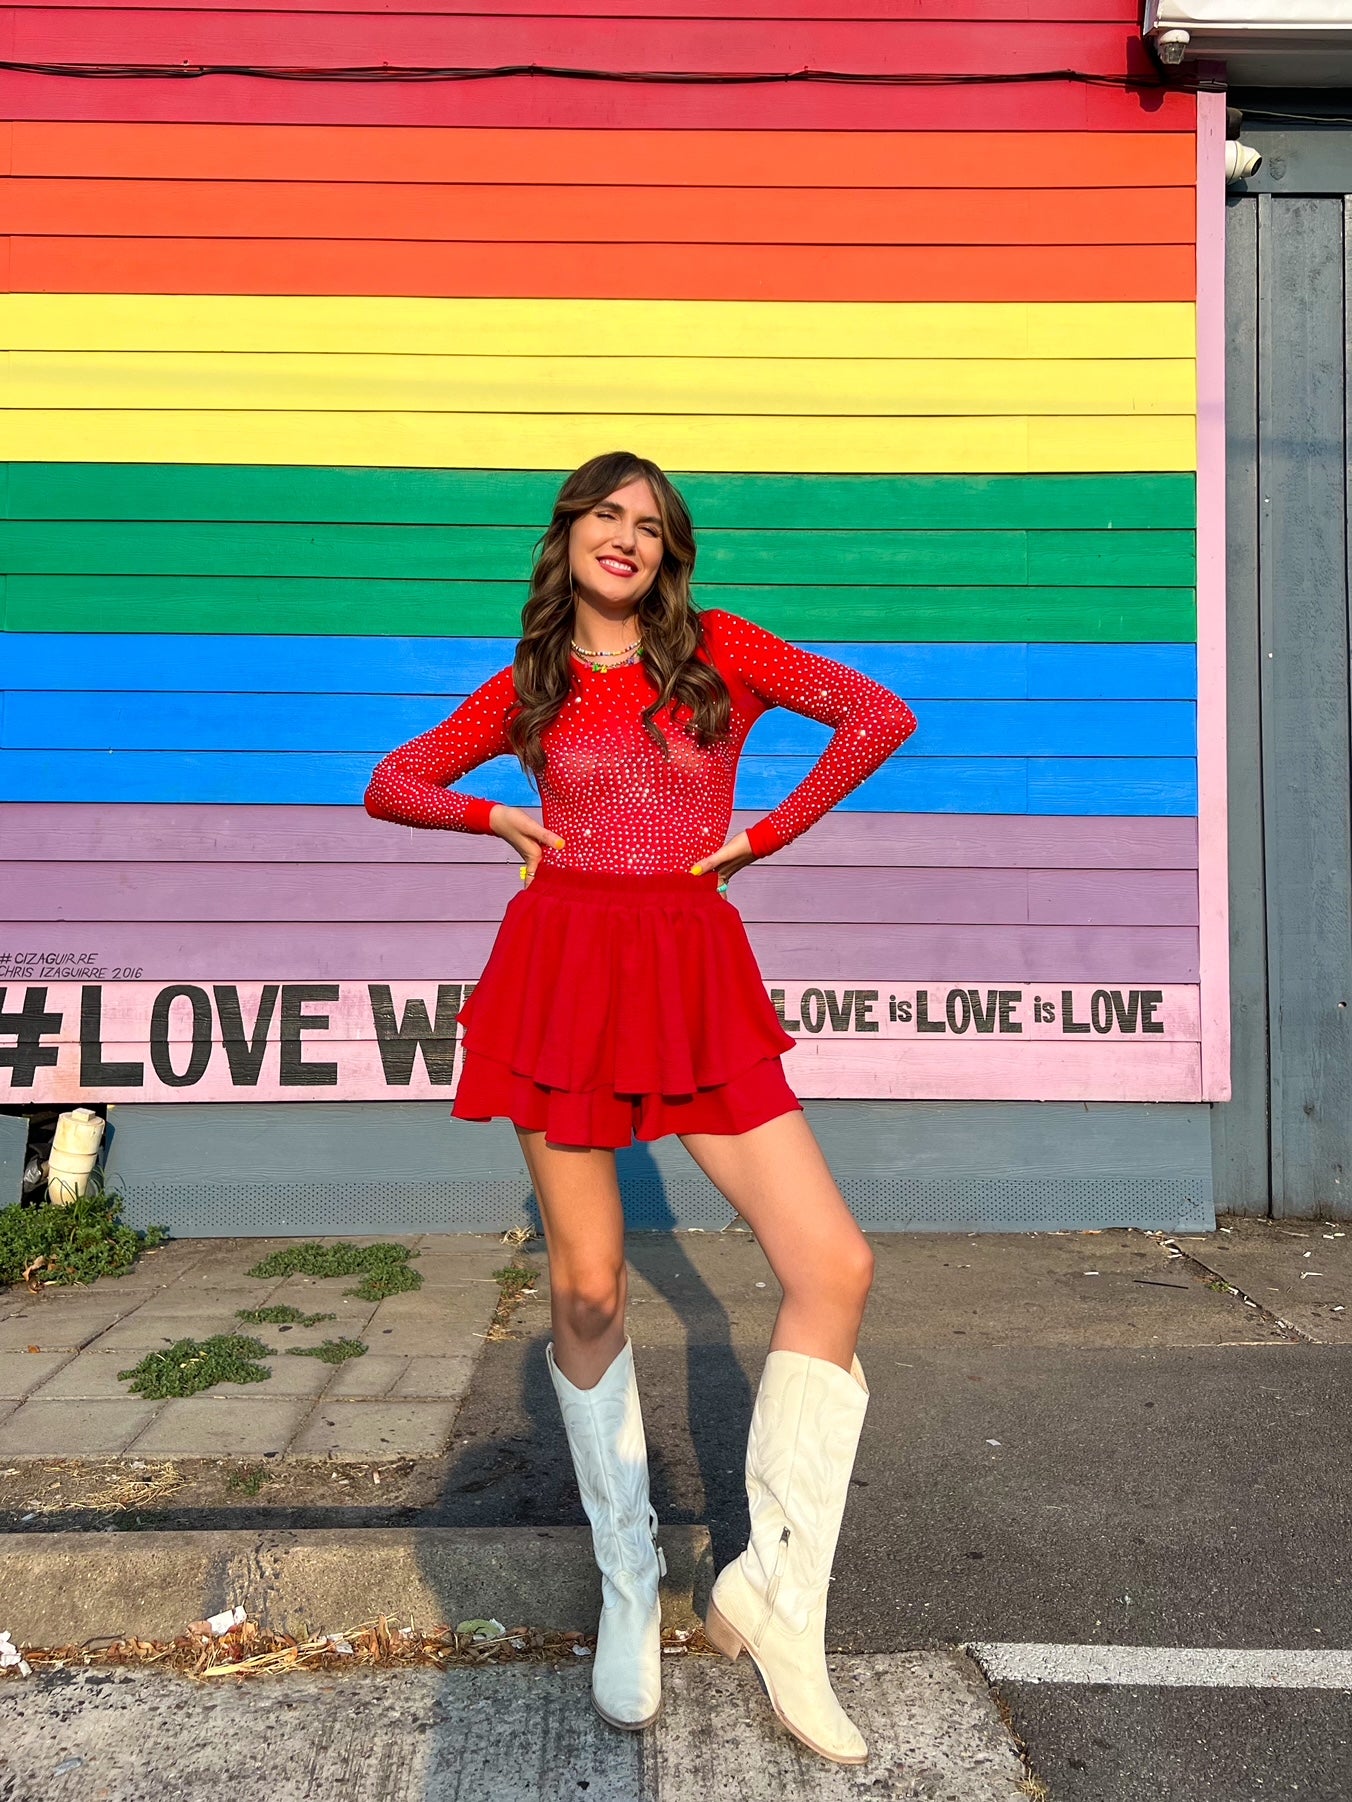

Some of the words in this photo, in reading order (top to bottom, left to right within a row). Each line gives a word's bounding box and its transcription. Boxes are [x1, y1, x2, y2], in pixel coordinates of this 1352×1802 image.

[0, 965, 34, 978] CHRIS
[39, 966, 108, 979] IZAGUIRRE
[112, 967, 143, 979] 2016
[771, 988, 879, 1033] LOVE
[889, 995, 912, 1022] is
[917, 988, 1022, 1034] LOVE
[1034, 995, 1056, 1024] is
[1063, 989, 1164, 1034] LOVE
[367, 984, 478, 1086] W
